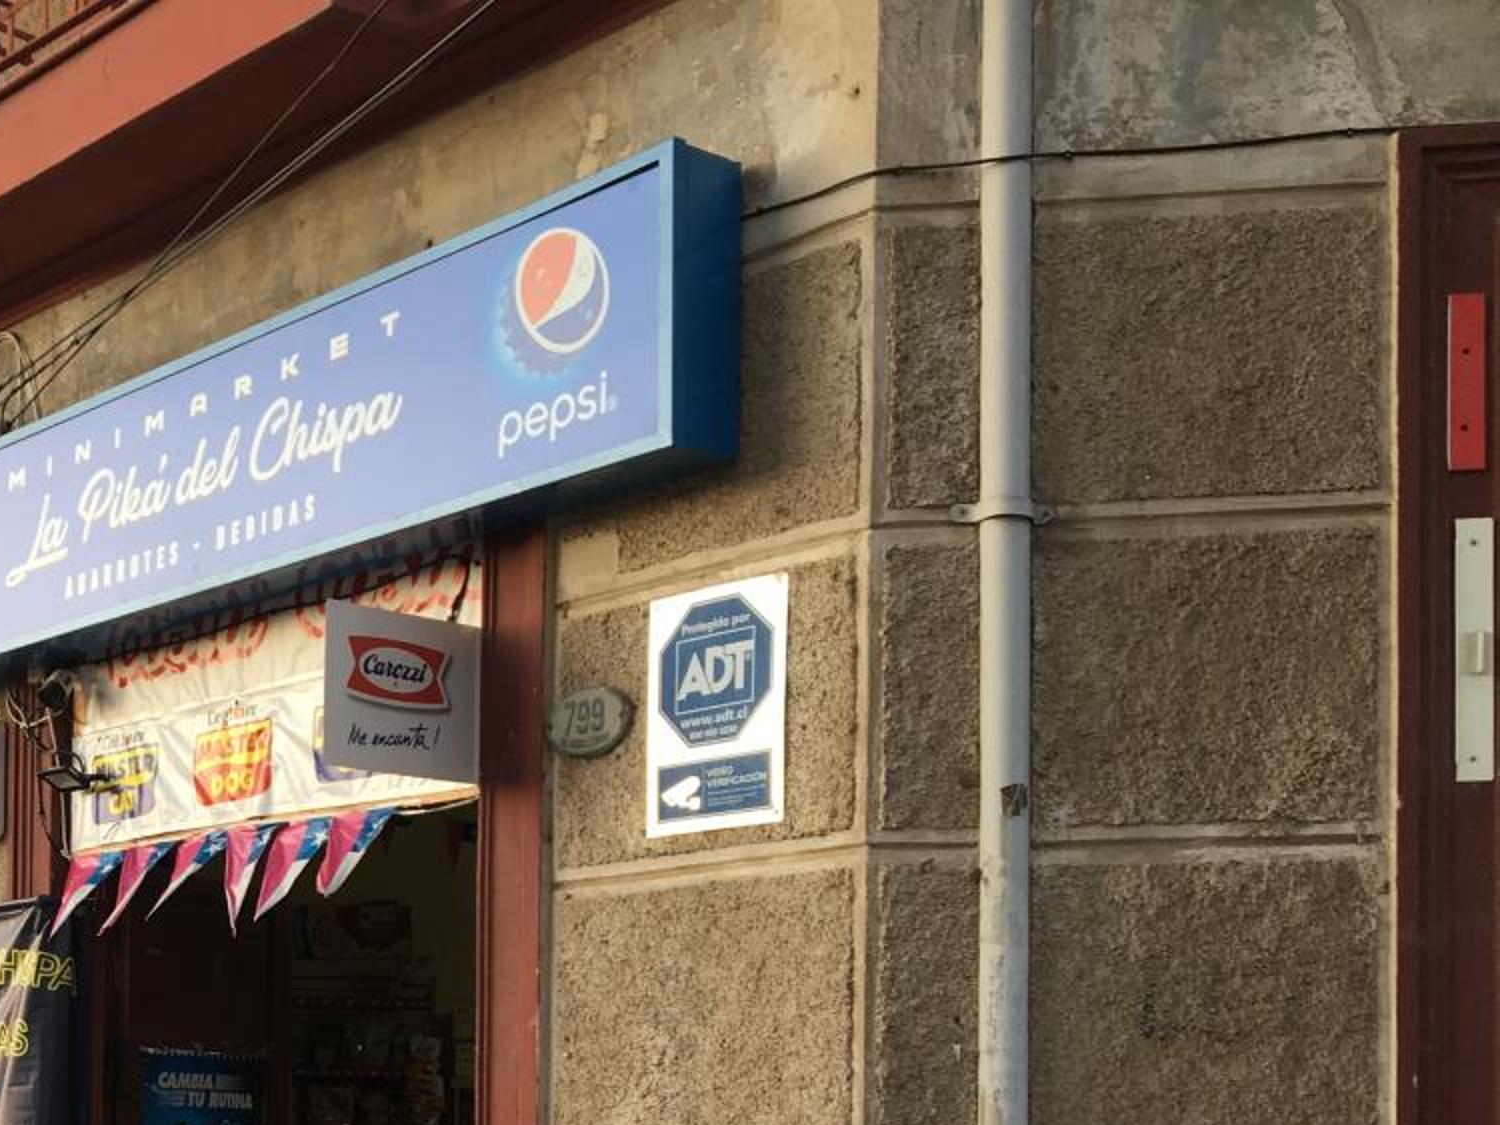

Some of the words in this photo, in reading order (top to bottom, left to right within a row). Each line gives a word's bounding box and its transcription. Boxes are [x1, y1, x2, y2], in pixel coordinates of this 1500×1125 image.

[7, 310, 400, 492] MINIMARKET
[498, 370, 607, 459] pepsi
[5, 493, 69, 587] La
[175, 425, 241, 505] del
[249, 392, 403, 481] Chispa
[64, 541, 179, 600] ABARROTES
[216, 494, 315, 551] BEBIDAS
[363, 653, 427, 682] Carozzi
[677, 640, 754, 700] ADT
[563, 697, 605, 737] 799
[211, 770, 254, 796] DOG
